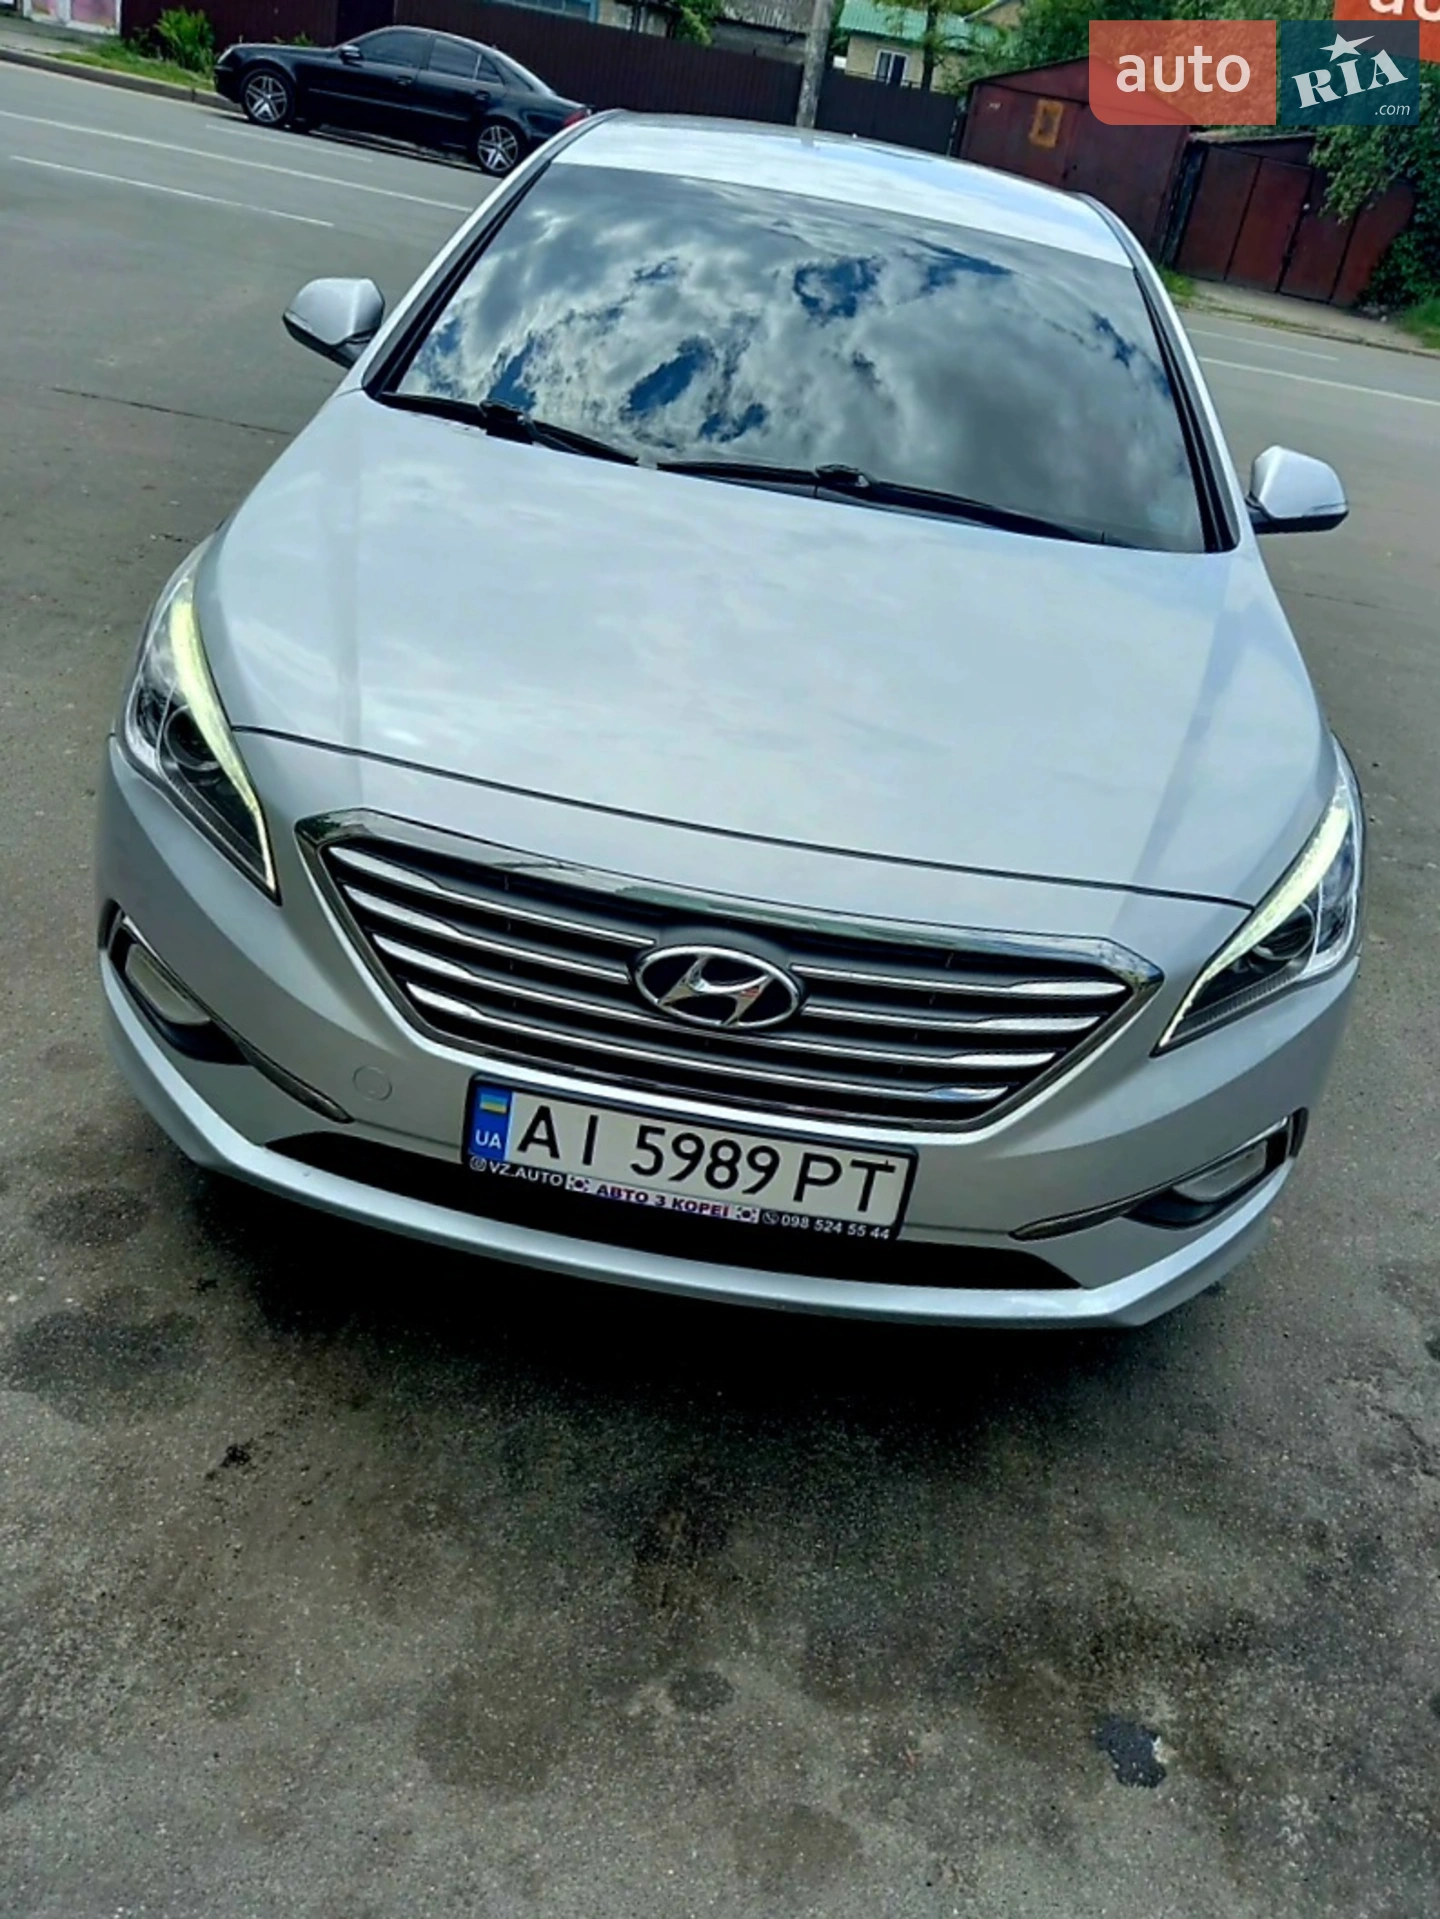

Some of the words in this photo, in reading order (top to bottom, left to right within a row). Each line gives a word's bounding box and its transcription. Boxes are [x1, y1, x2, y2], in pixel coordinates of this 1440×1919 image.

[475, 1129, 502, 1150] UA
[517, 1105, 599, 1166] AI
[630, 1125, 780, 1195] 5989
[793, 1152, 897, 1213] PT
[597, 1184, 649, 1204] АВТО
[781, 1214, 811, 1229] 098
[814, 1219, 843, 1234] 524
[847, 1223, 867, 1238] 55
[869, 1227, 890, 1240] 44
